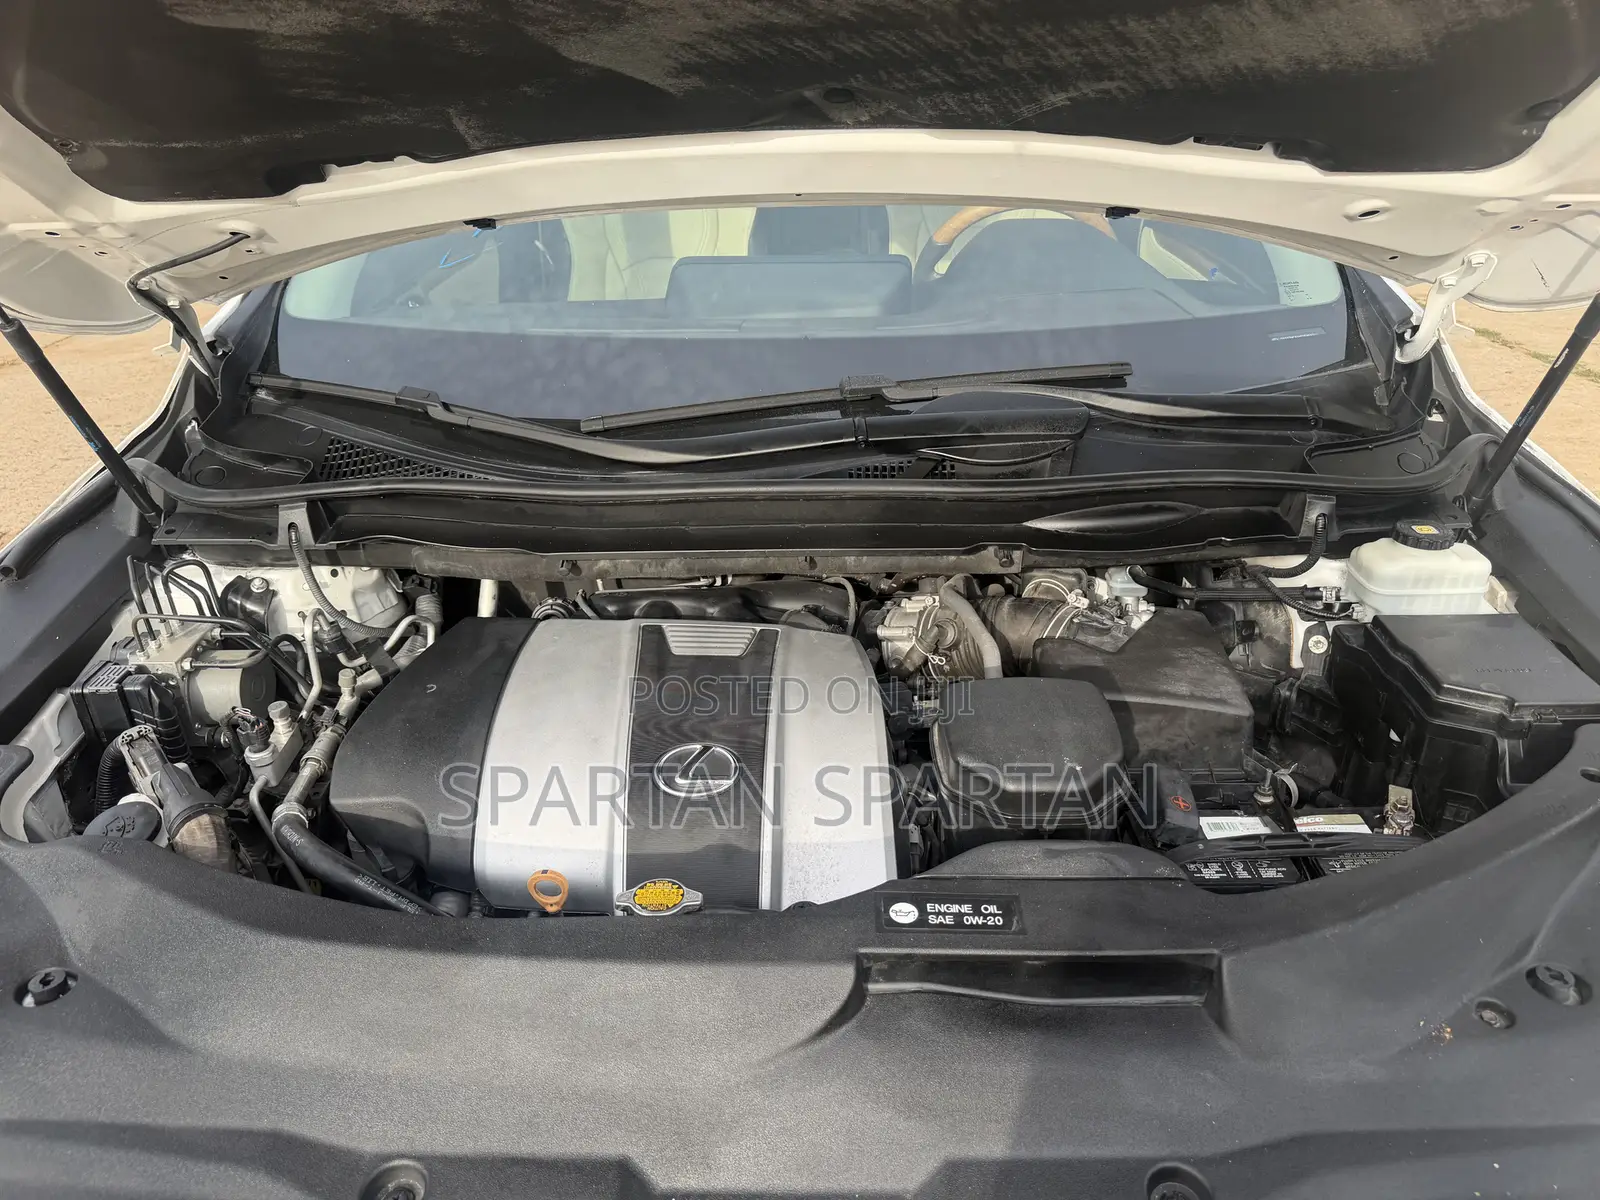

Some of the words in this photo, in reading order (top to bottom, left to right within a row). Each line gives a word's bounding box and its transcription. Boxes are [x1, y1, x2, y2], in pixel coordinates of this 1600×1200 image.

[926, 903, 973, 914] ENGINE
[981, 904, 1002, 914] OIL
[928, 915, 954, 925] SAE
